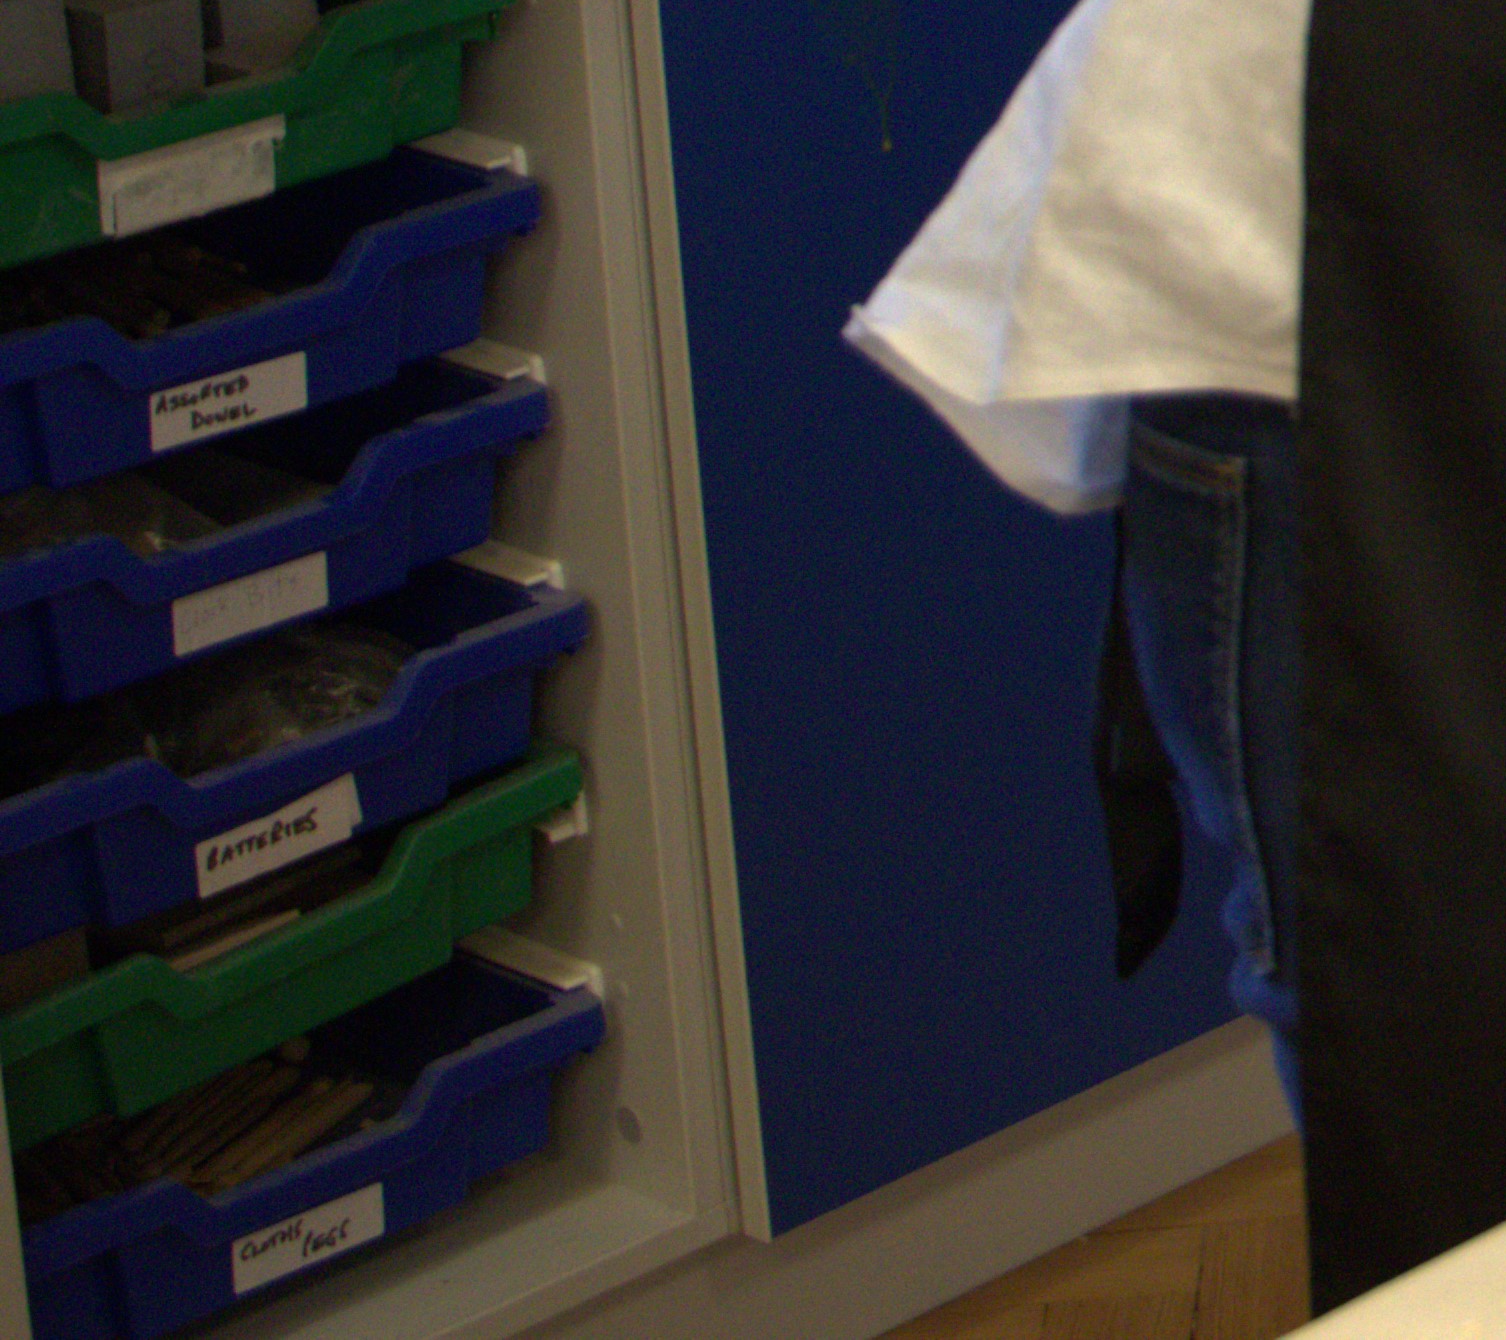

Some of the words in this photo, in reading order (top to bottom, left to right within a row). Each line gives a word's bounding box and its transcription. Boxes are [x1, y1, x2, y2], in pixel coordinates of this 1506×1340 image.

[155, 374, 250, 415] ASSORTED
[190, 402, 258, 431] DOWEL
[207, 806, 318, 872] BATTERIES
